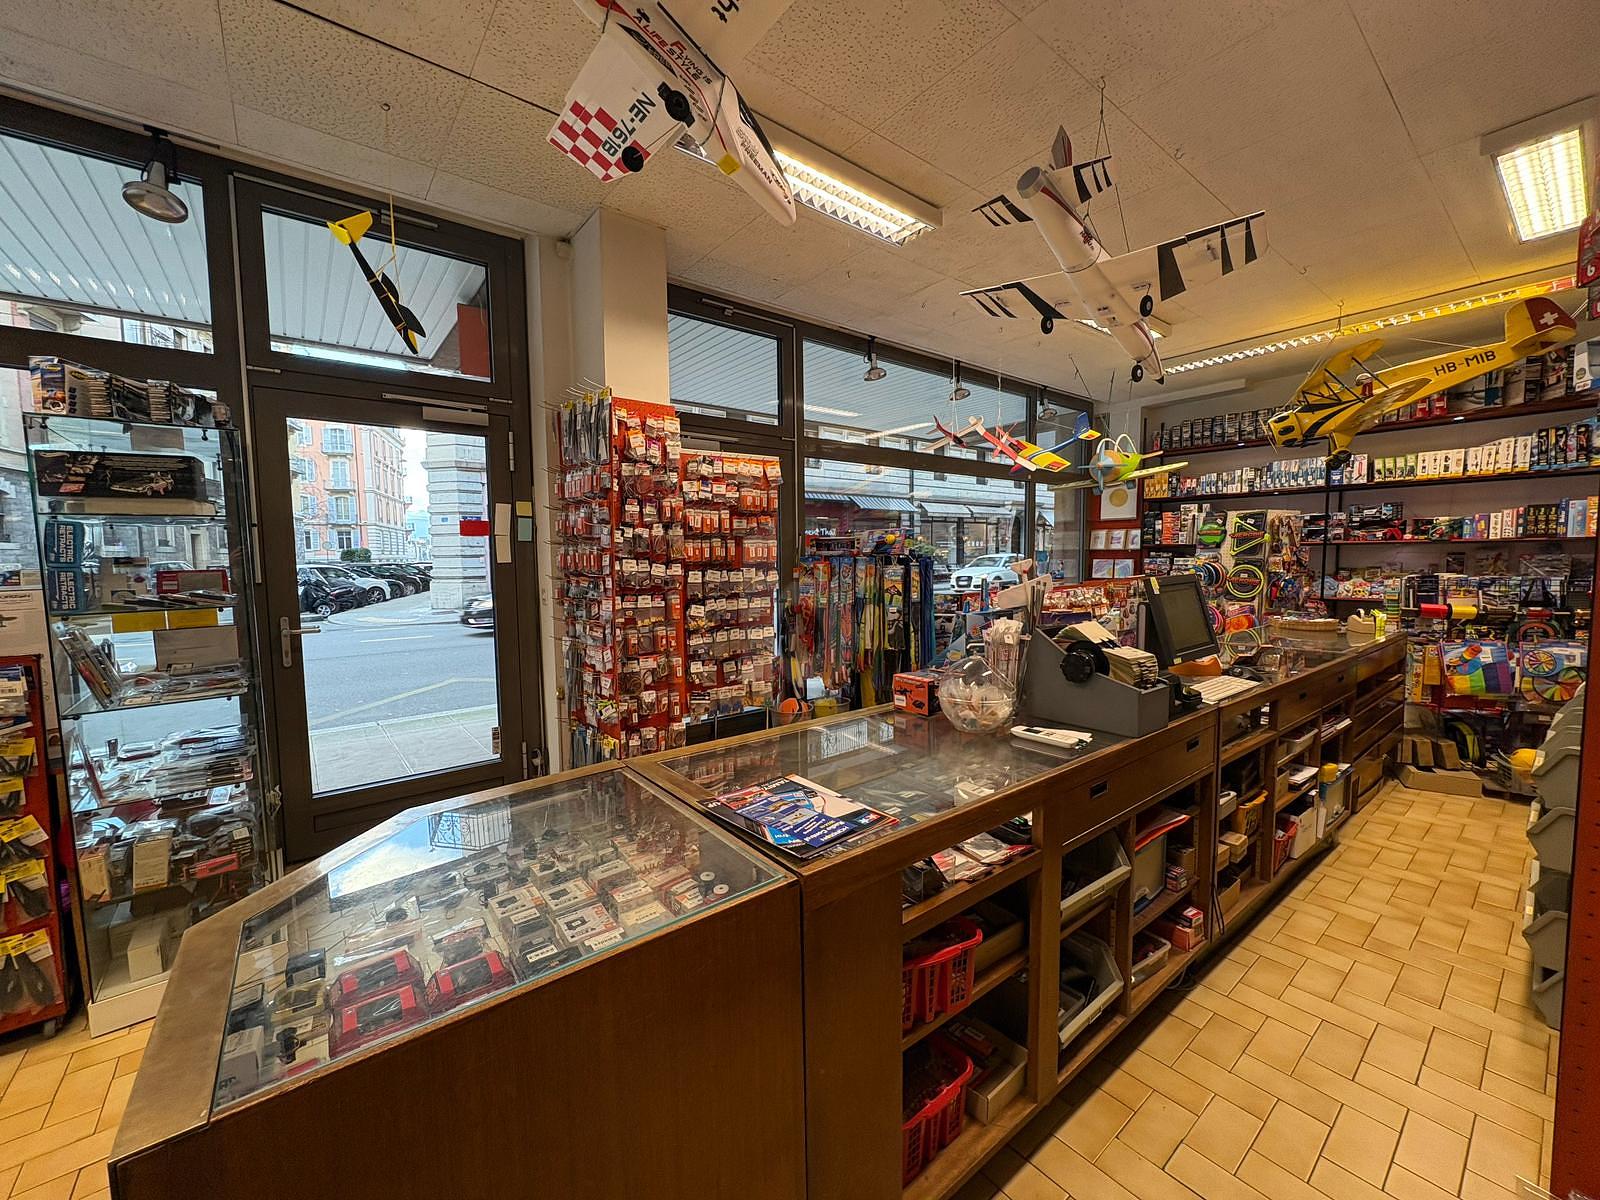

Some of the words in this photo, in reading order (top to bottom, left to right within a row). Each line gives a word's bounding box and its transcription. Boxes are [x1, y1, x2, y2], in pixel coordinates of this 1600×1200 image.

[601, 91, 656, 158] NE-761B
[66, 525, 74, 563] ELECTRIC
[66, 572, 76, 609] ELECTRIC
